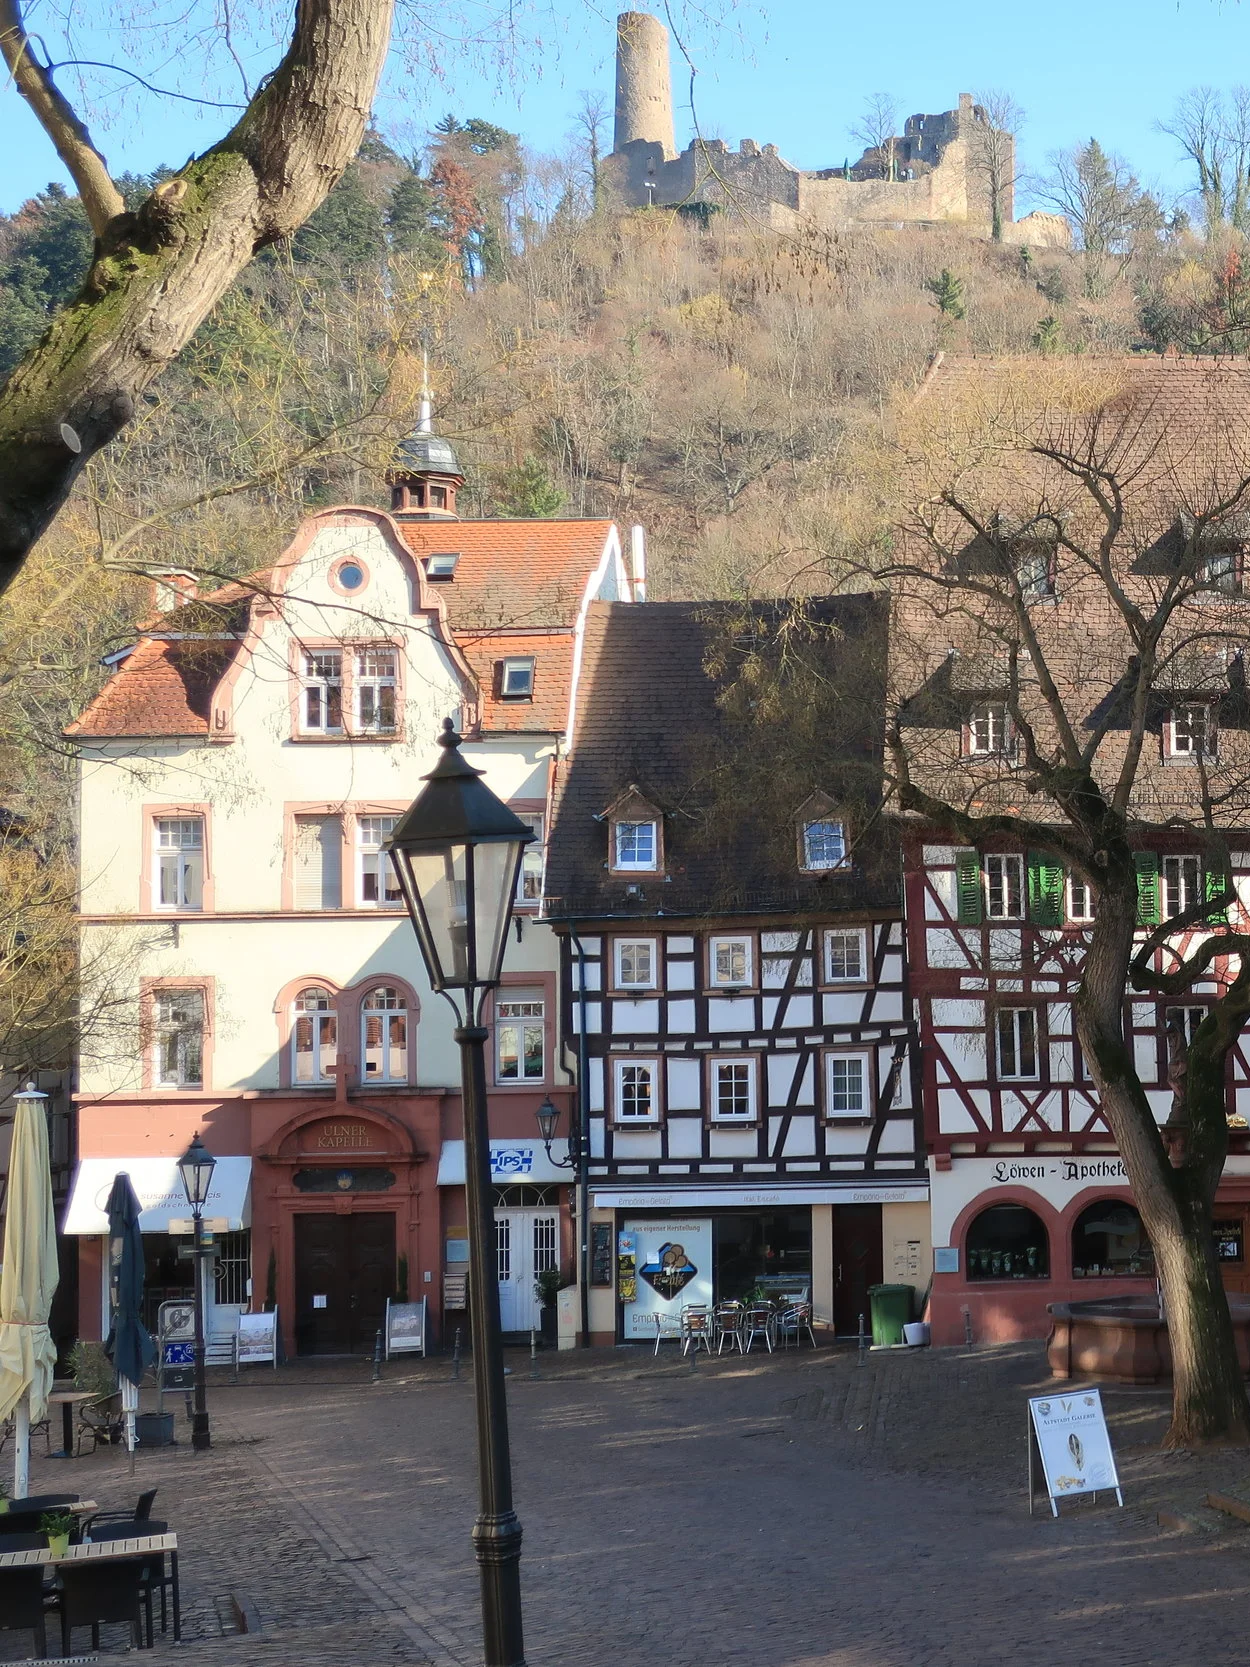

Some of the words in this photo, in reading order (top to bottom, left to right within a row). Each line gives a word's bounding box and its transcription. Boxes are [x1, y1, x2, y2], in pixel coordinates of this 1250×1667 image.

[324, 1125, 367, 1136] ULNER
[318, 1136, 373, 1148] KAPELLE
[499, 1156, 520, 1166] IPS
[991, 1161, 1045, 1182] Löwen
[141, 1191, 184, 1200] susanne
[644, 1225, 666, 1233] eigener
[667, 1224, 701, 1233] Herstellung
